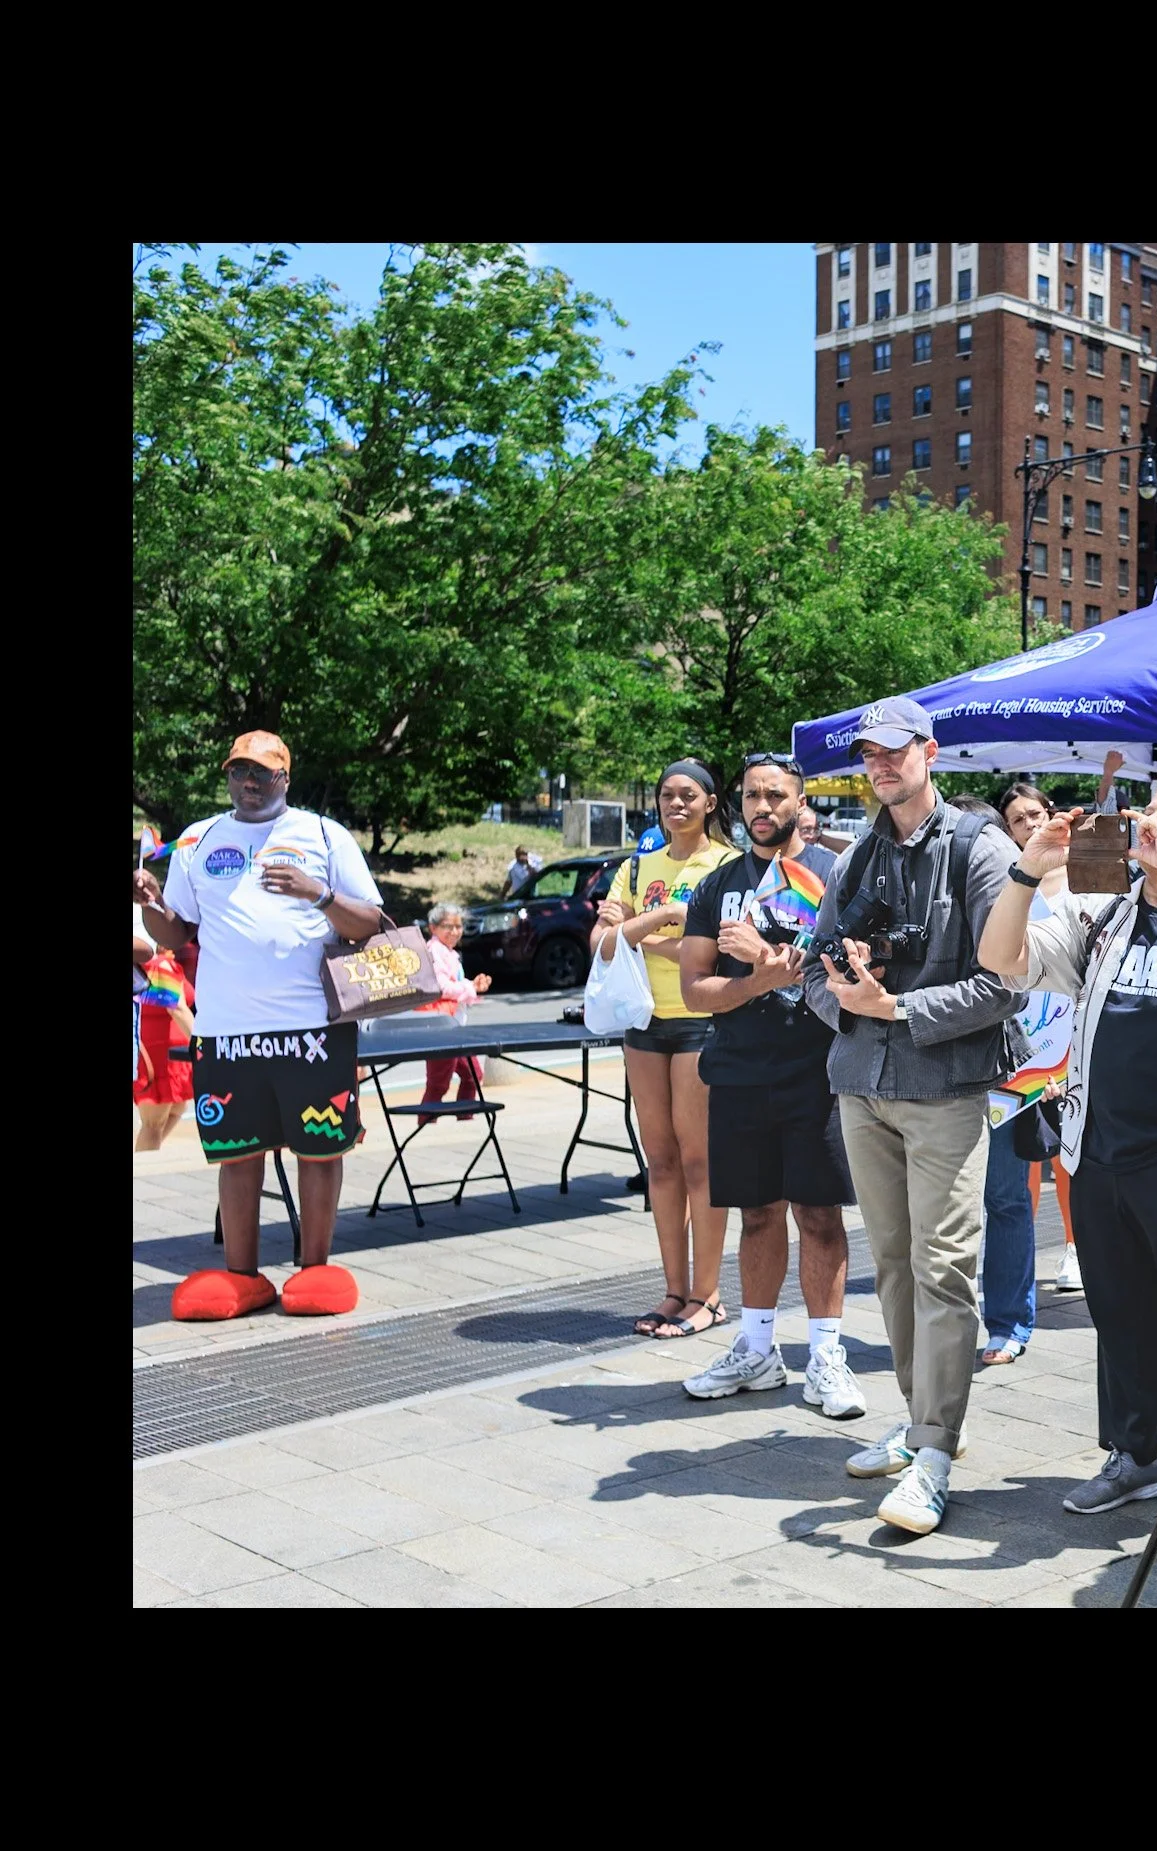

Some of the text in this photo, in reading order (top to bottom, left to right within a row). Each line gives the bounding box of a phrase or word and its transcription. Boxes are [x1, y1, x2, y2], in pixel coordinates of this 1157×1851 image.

[965, 700, 992, 716] Free
[991, 698, 1026, 719] Legal
[1024, 697, 1075, 718] Housing
[1074, 696, 1126, 714] Services
[354, 943, 394, 963] THE
[367, 974, 408, 992] BAG
[215, 1031, 329, 1064] MALCOLM X
